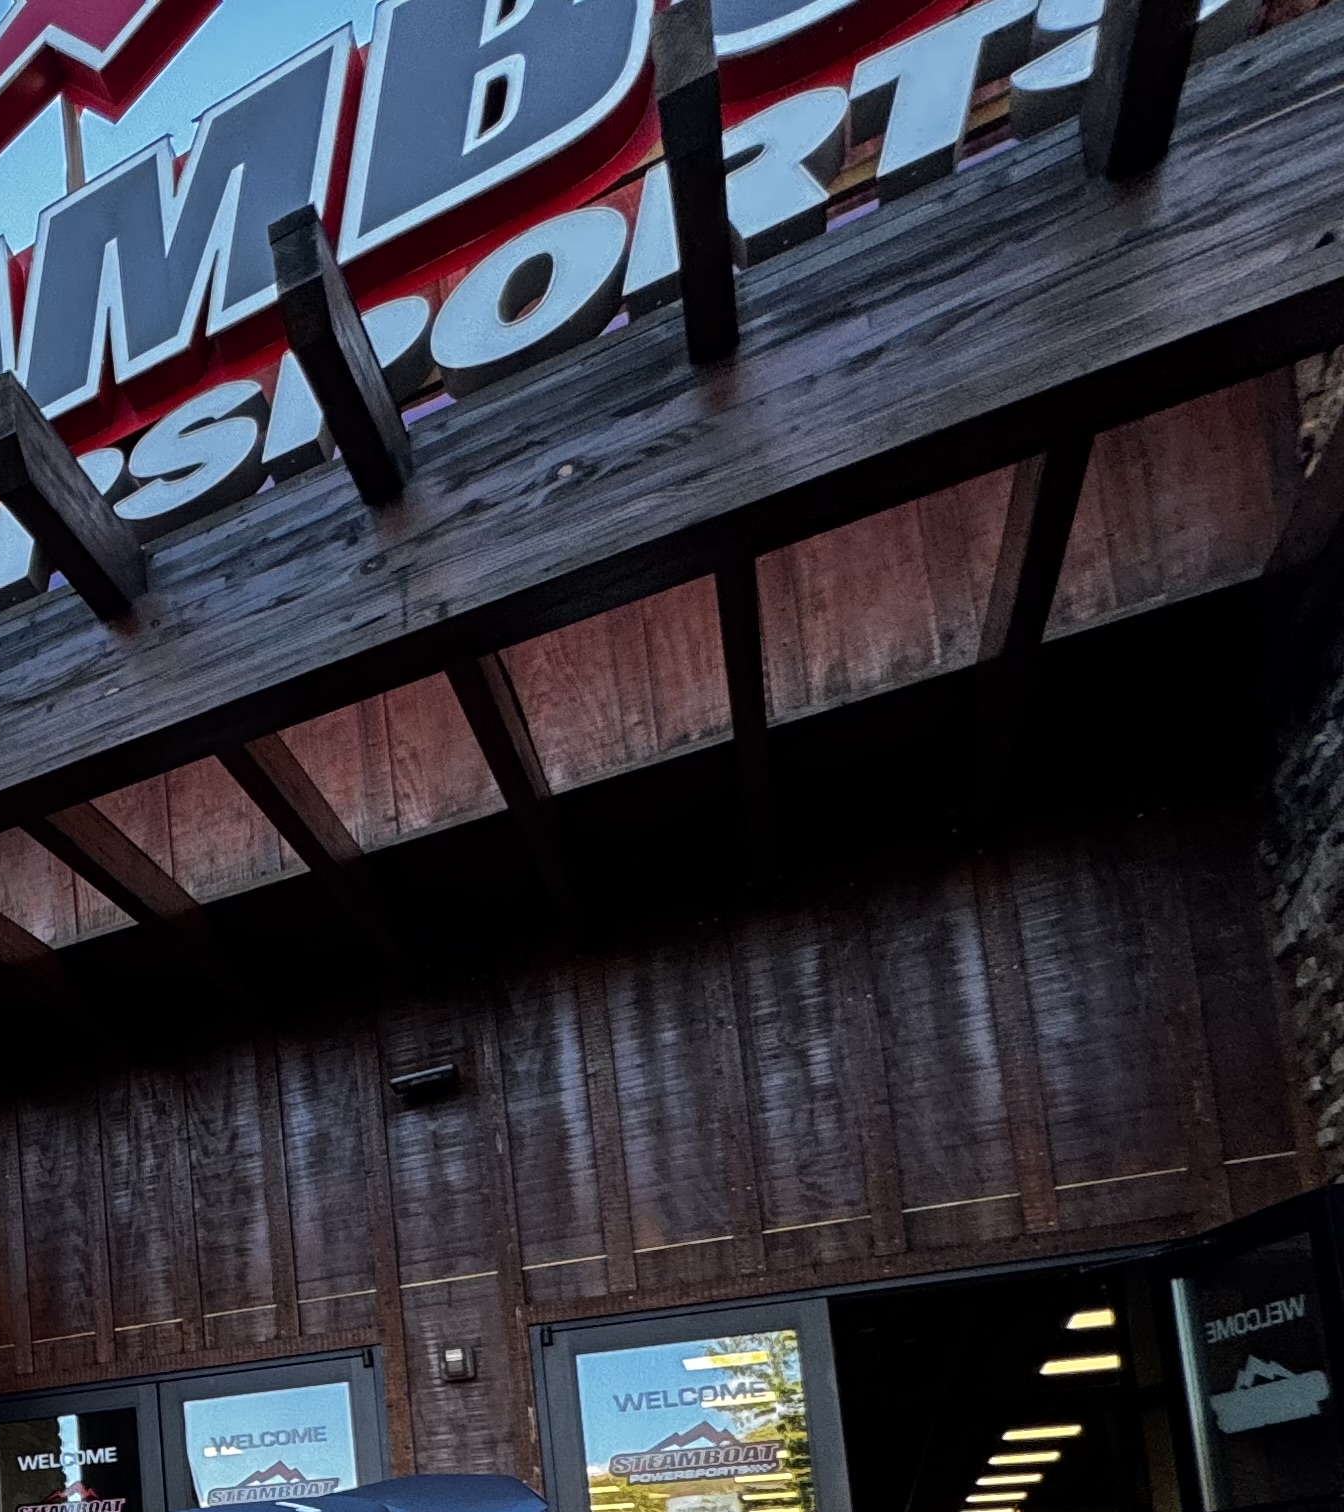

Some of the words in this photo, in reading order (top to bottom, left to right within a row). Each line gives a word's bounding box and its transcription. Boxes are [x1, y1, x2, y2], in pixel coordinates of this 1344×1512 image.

[612, 1381, 767, 1412] WELCOME
[210, 1426, 327, 1450] WELCOME
[17, 1446, 118, 1471] WELCOME
[612, 1444, 780, 1474] STEAMBOAT
[629, 1465, 749, 1484] POWERSPORTS
[211, 1480, 336, 1504] STEAMBOAT
